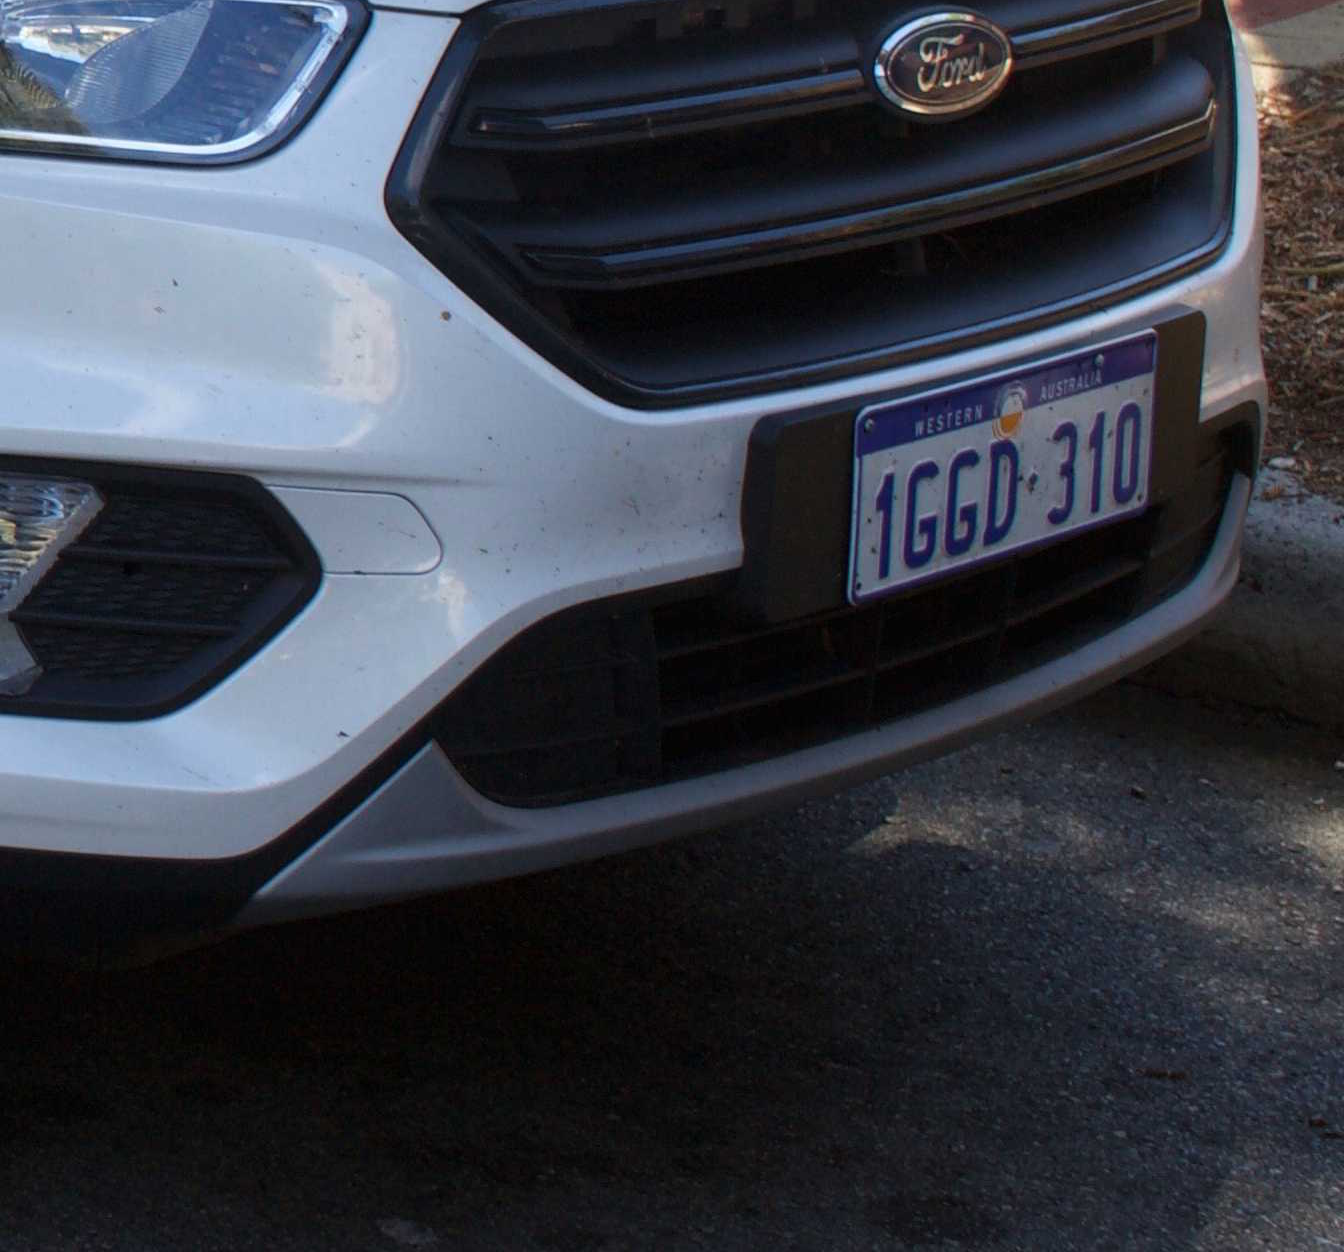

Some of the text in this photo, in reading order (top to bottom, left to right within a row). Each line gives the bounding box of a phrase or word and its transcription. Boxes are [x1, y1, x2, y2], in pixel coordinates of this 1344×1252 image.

[917, 34, 988, 93] Ford
[914, 368, 1104, 438] WESTERN AUSTRALIA
[875, 401, 1142, 581] 1GGD 310
